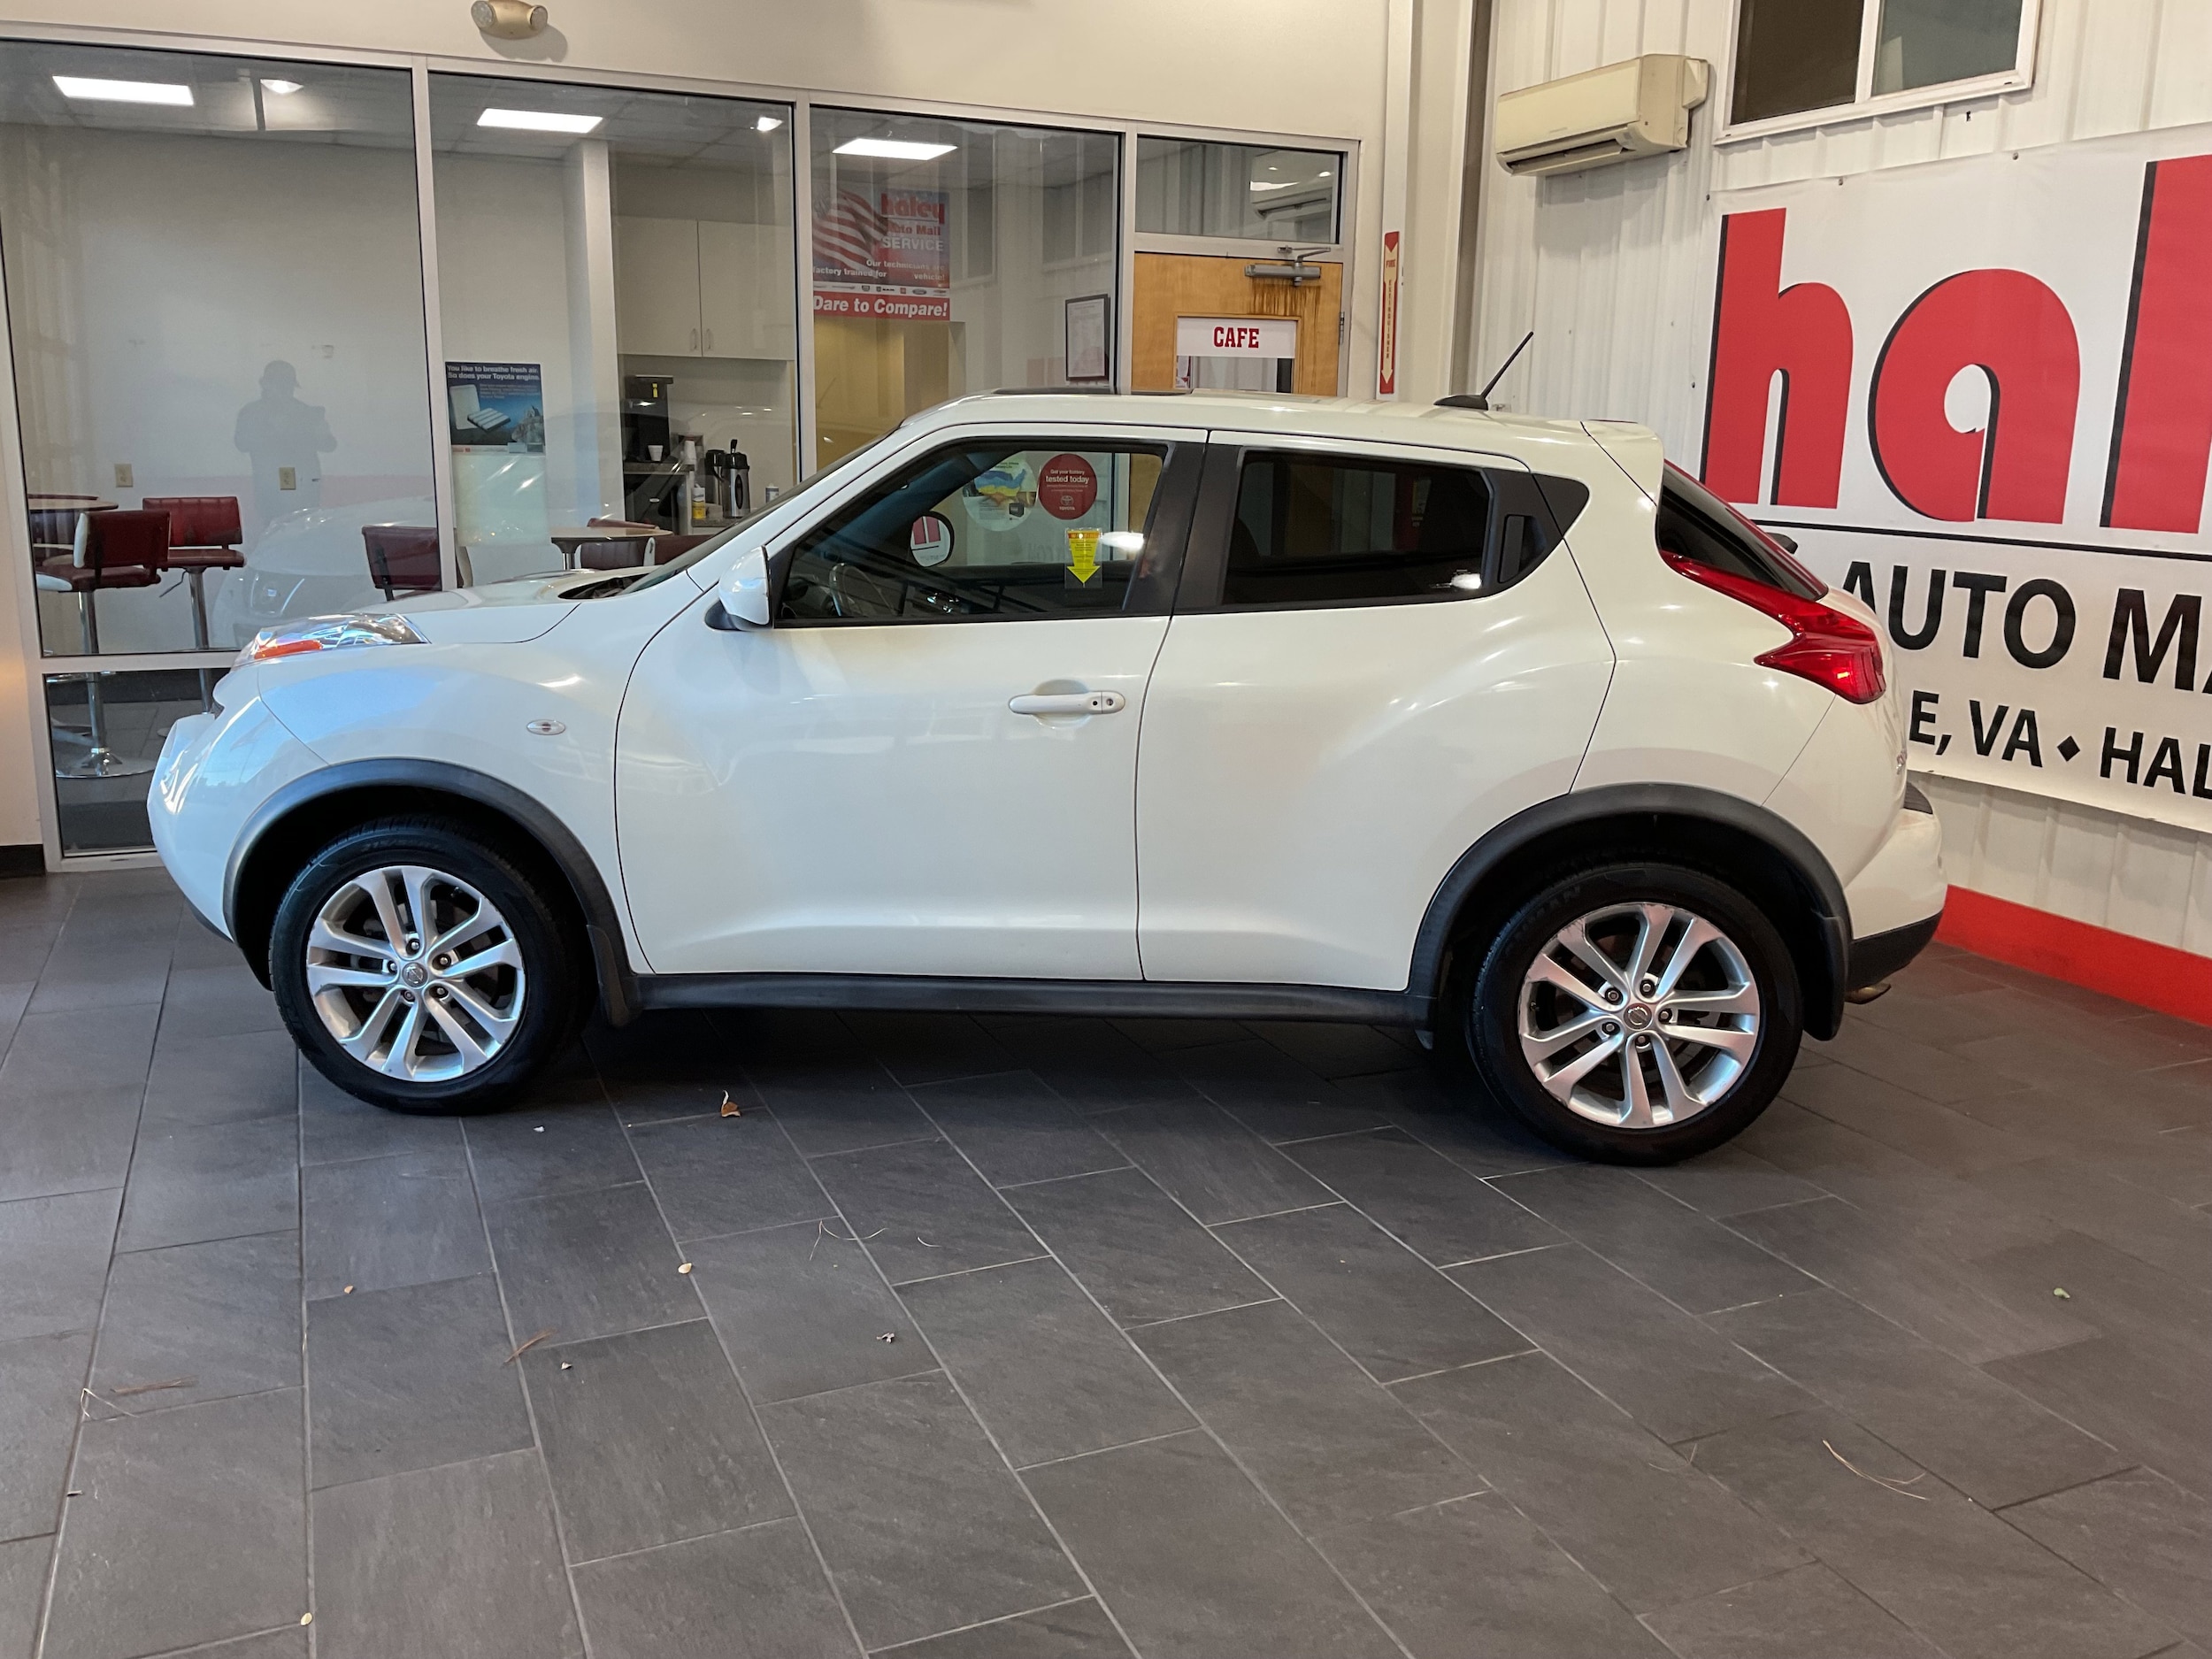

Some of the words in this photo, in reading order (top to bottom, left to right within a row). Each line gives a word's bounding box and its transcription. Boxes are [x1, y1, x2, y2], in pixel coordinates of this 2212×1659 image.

[916, 225, 941, 236] Mall
[881, 236, 944, 251] SERVICE
[844, 268, 872, 277] trained
[875, 270, 887, 279] for
[813, 296, 849, 311] Dare
[854, 298, 870, 312] to
[874, 298, 949, 318] Compare!
[1213, 326, 1259, 349] CAFE
[1070, 475, 1089, 485] today
[1842, 561, 2077, 670] AUTO
[2103, 588, 2212, 695] M
[1970, 700, 2043, 768] VA
